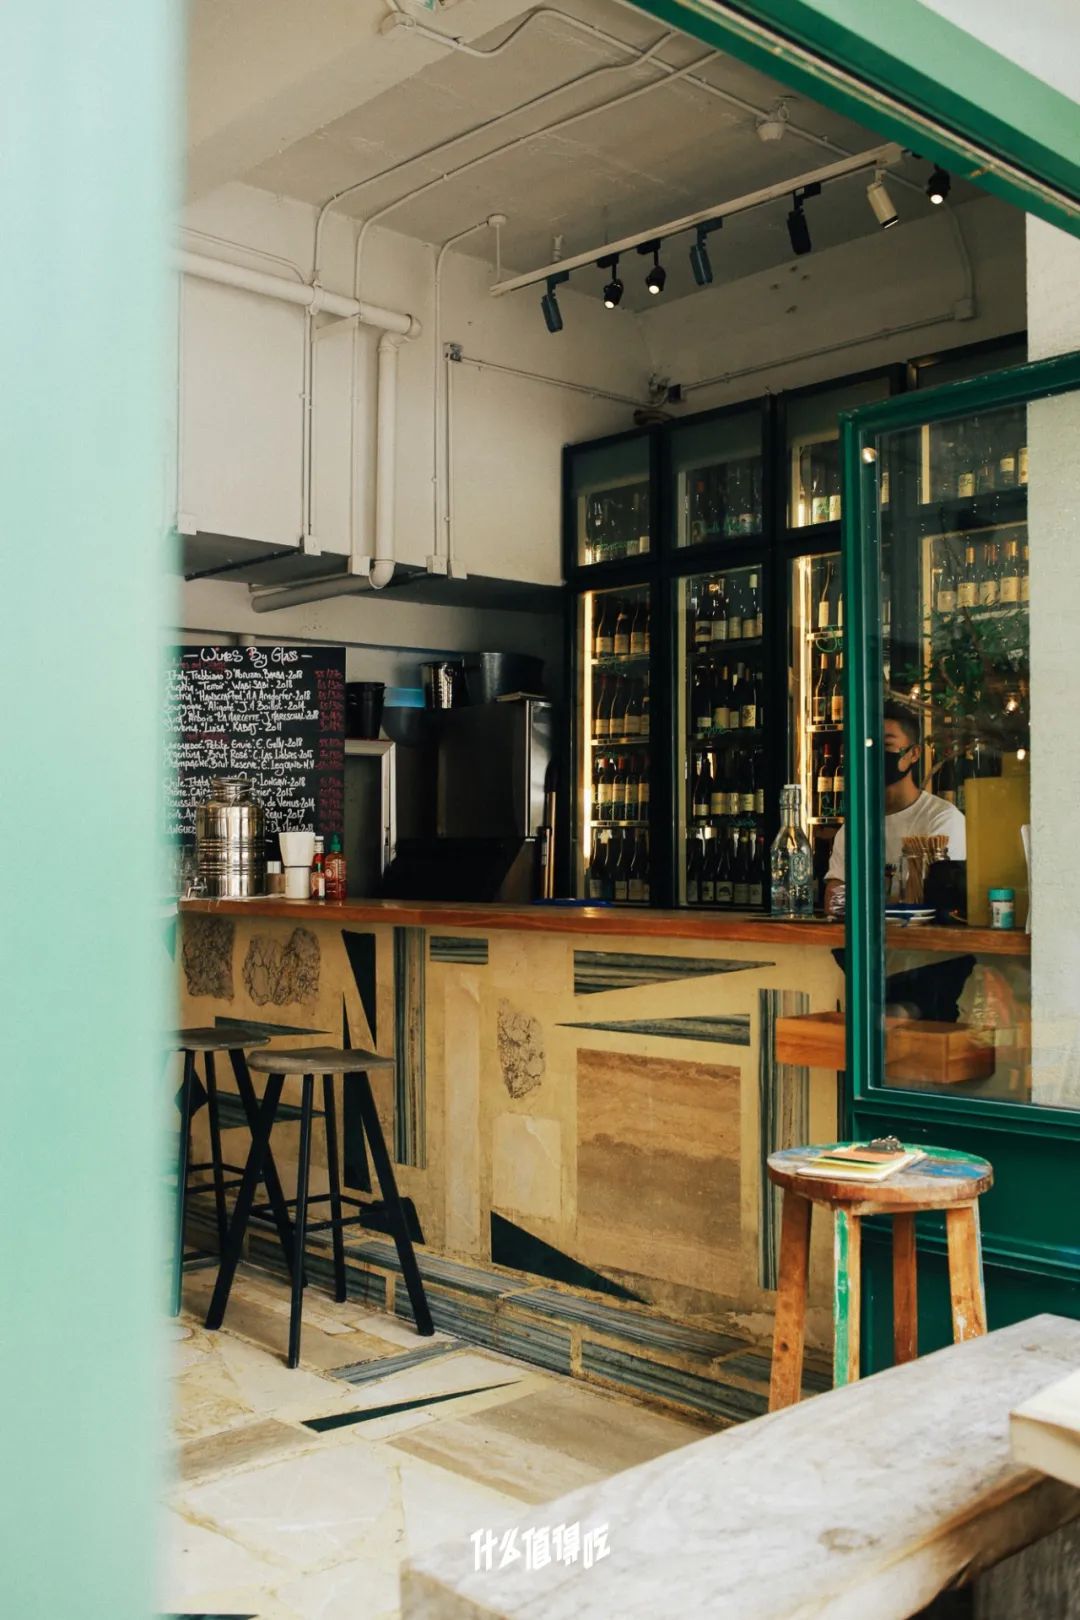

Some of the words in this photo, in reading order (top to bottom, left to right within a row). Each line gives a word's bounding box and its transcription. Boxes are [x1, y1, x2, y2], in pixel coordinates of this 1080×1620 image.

[201, 647, 244, 663] Wines
[246, 647, 268, 669] By
[271, 647, 299, 666] Glass
